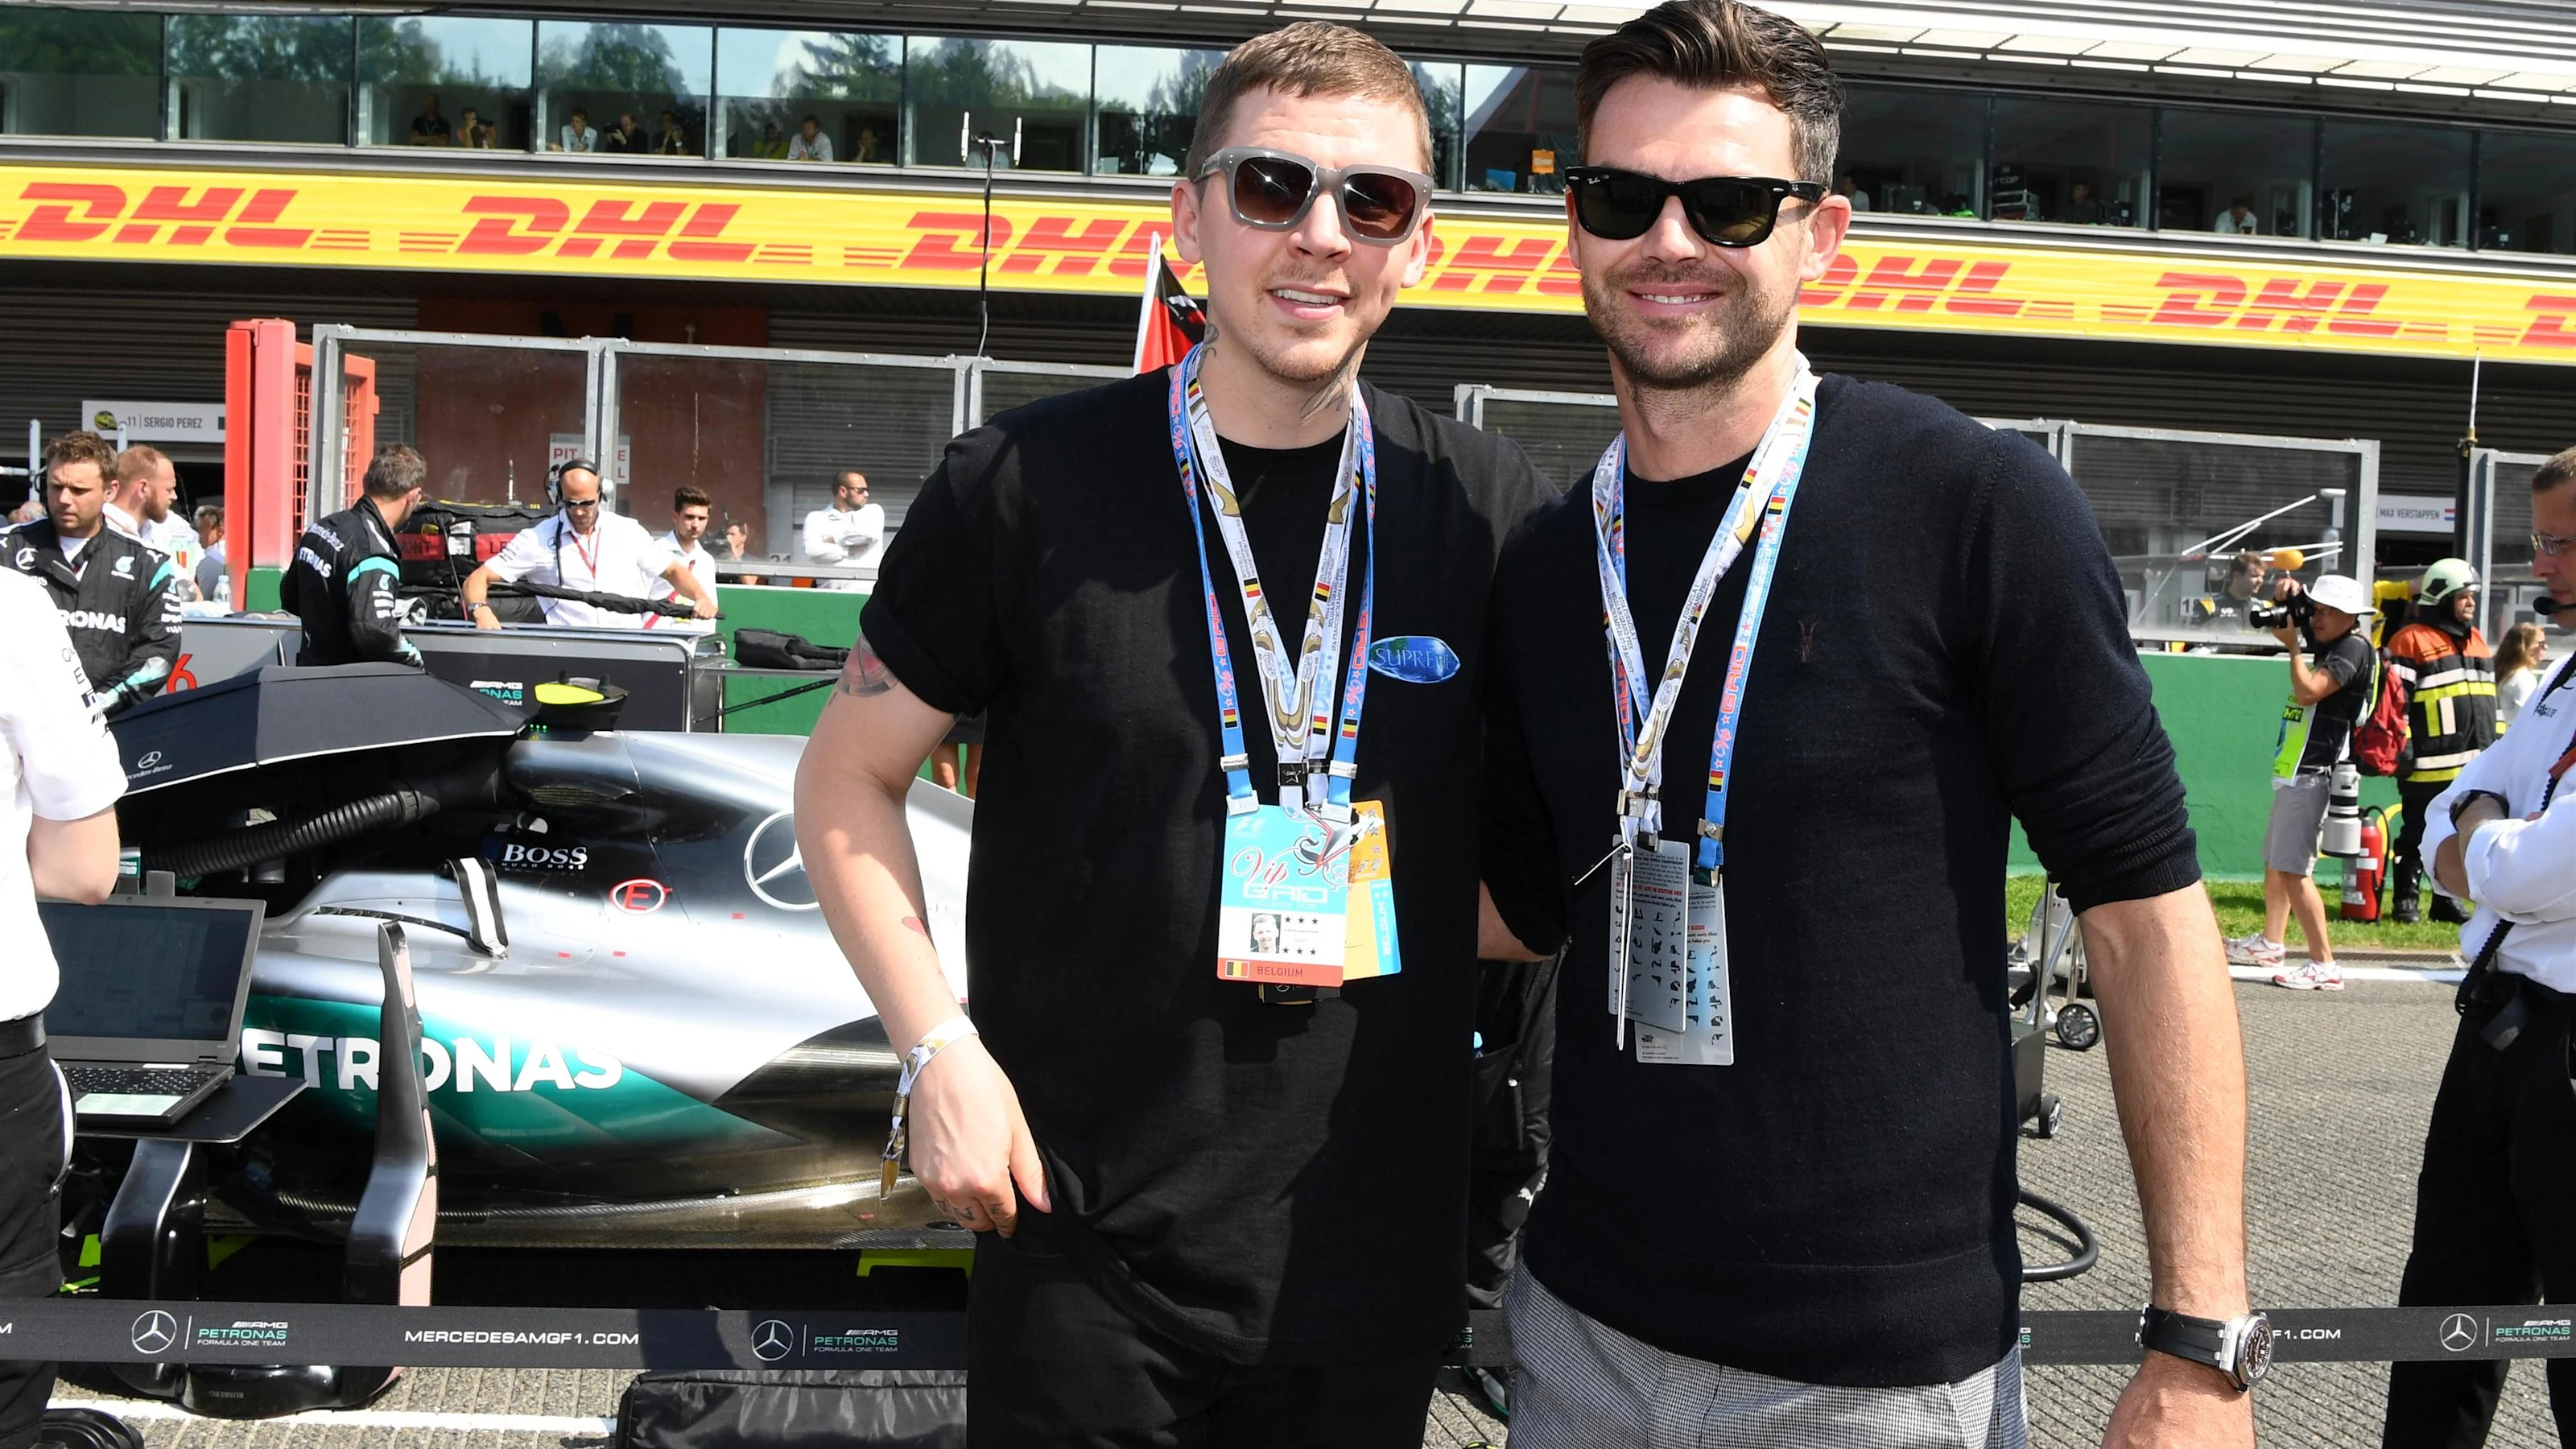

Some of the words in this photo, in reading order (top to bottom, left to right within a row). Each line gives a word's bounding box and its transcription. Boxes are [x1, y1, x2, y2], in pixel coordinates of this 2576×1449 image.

[14, 182, 313, 248] DHL
[456, 196, 758, 262] DHL
[901, 212, 1195, 279] DHL
[2151, 271, 2403, 337] DHL
[127, 417, 136, 427] 11
[143, 417, 175, 427] SERGIO
[177, 418, 203, 429] PEREZ
[554, 448, 578, 460] PIT
[2380, 509, 2394, 518] MAX
[2397, 509, 2440, 519] VERSTAPPEN
[1682, 588, 1699, 619] FORMULA
[60, 609, 126, 634] RONAS
[1622, 609, 1636, 637] FORMULA
[1720, 645, 1748, 714] GRID
[126, 764, 173, 780] rcedes-Benz
[503, 844, 588, 865] BOSS
[1231, 847, 1288, 885] Vip
[1257, 966, 1303, 977] BELGIUM
[242, 1027, 623, 1093] ETRONAS
[199, 1328, 287, 1340] PETRONAS
[404, 1330, 639, 1345] MERCEDESAMGF1.COM
[815, 1336, 898, 1346] PETRONAS
[2496, 1327, 2570, 1336] PETRONAS
